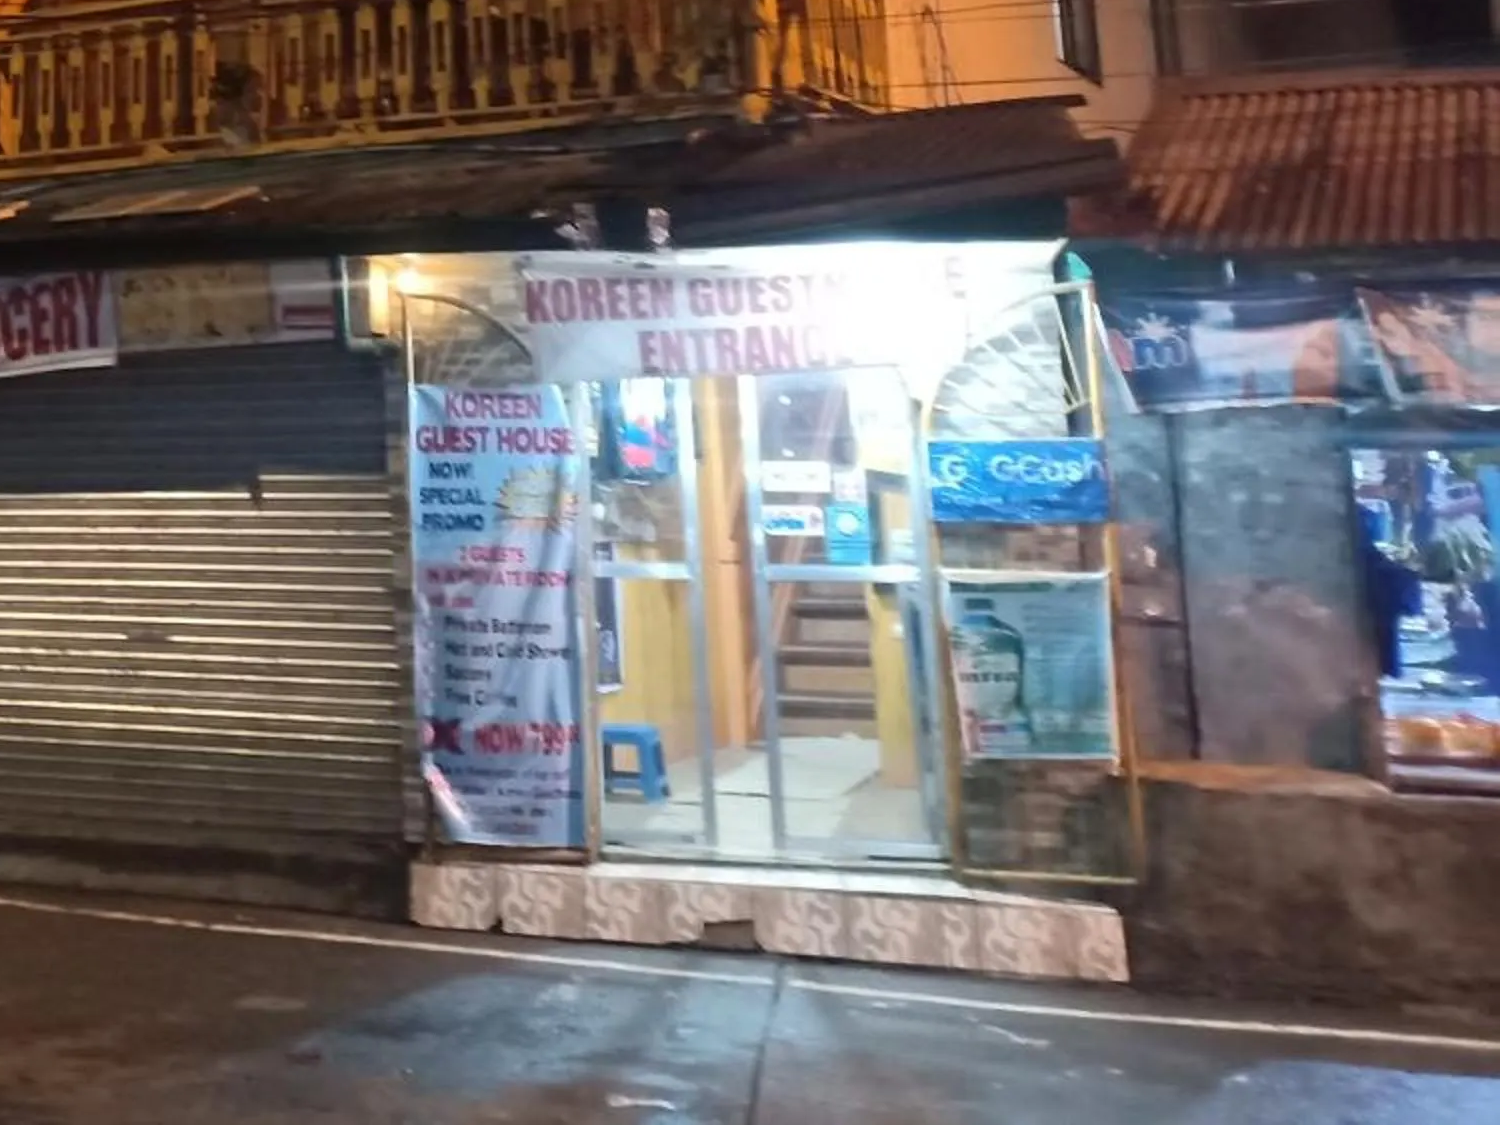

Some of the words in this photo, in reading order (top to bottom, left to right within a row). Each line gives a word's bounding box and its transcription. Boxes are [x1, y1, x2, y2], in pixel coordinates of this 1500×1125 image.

[525, 273, 676, 324] KOREEN
[637, 324, 852, 375] ENTRANC
[446, 392, 542, 419] KOREEN
[416, 426, 491, 455] GUEST
[495, 426, 577, 455] HOUSE
[989, 452, 1106, 484] GCash
[419, 486, 487, 506] SPECIAL
[421, 512, 485, 533] PROMO
